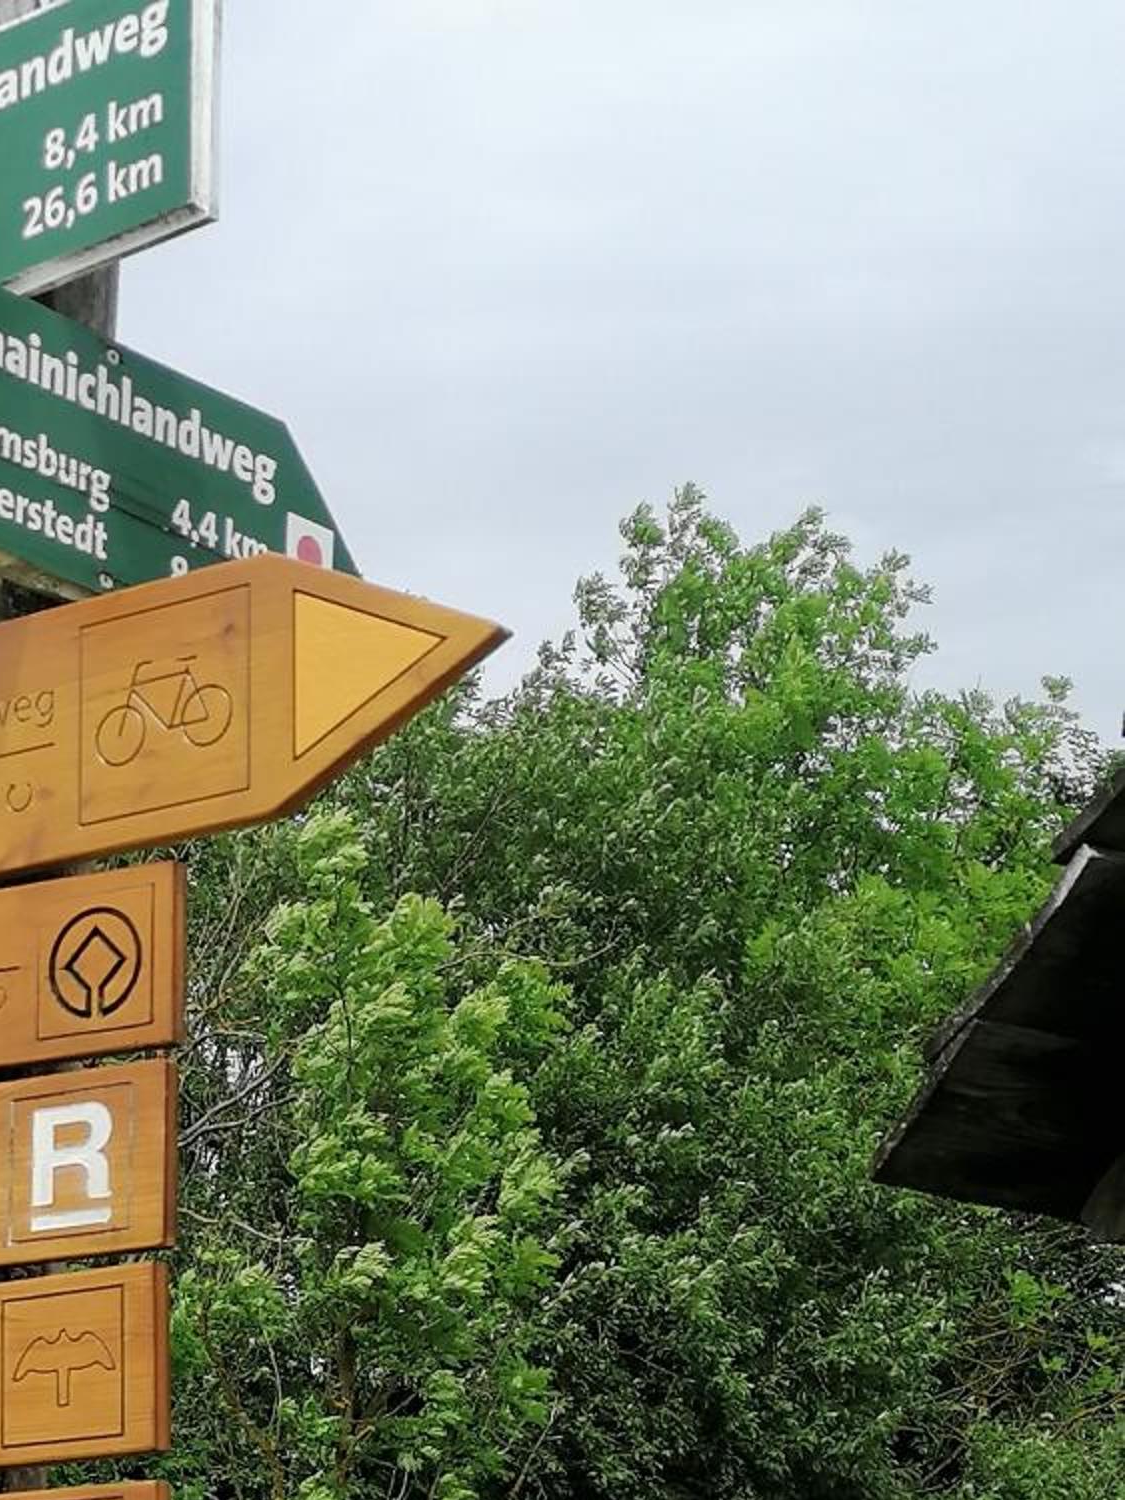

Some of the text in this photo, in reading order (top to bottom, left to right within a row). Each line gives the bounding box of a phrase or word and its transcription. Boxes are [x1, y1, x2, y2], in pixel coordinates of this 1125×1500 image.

[44, 91, 164, 170] 8,4 km
[23, 152, 164, 239] 26,6 km
[30, 1101, 113, 1208] R
